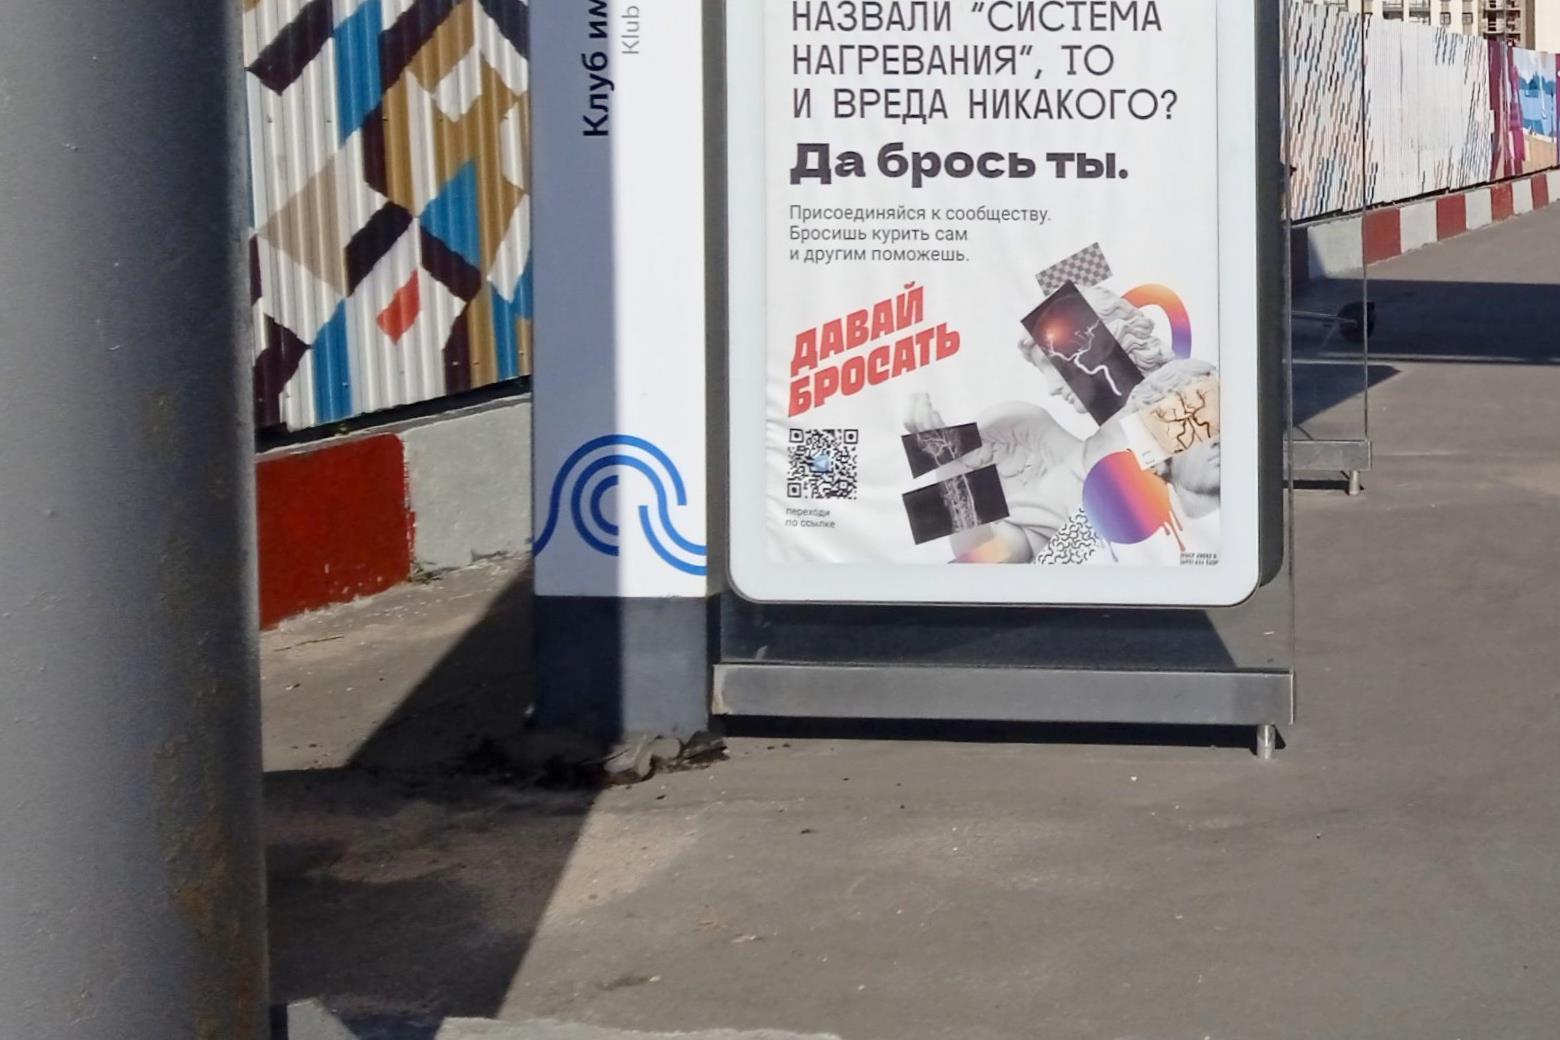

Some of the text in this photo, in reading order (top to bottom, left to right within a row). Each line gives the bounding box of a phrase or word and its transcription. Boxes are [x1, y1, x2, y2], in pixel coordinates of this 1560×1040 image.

[621, 5, 640, 55] Klub
[793, 0, 1162, 32] НАЗВАЛИ "СИСТЕМА
[1061, 44, 1114, 76] ТО
[581, 53, 614, 137] Клуб
[794, 88, 1177, 124] И ВРЕДА НИКАКОГО?
[790, 142, 1128, 188] Да брось ты.
[790, 205, 1050, 225] Присоединяйся к сообществу.
[790, 225, 967, 244] Бросишь курить сам
[790, 249, 968, 264] и другим поможешь.
[791, 280, 924, 377] ДАВАЙ
[788, 322, 960, 418] БРОСАТЬ
